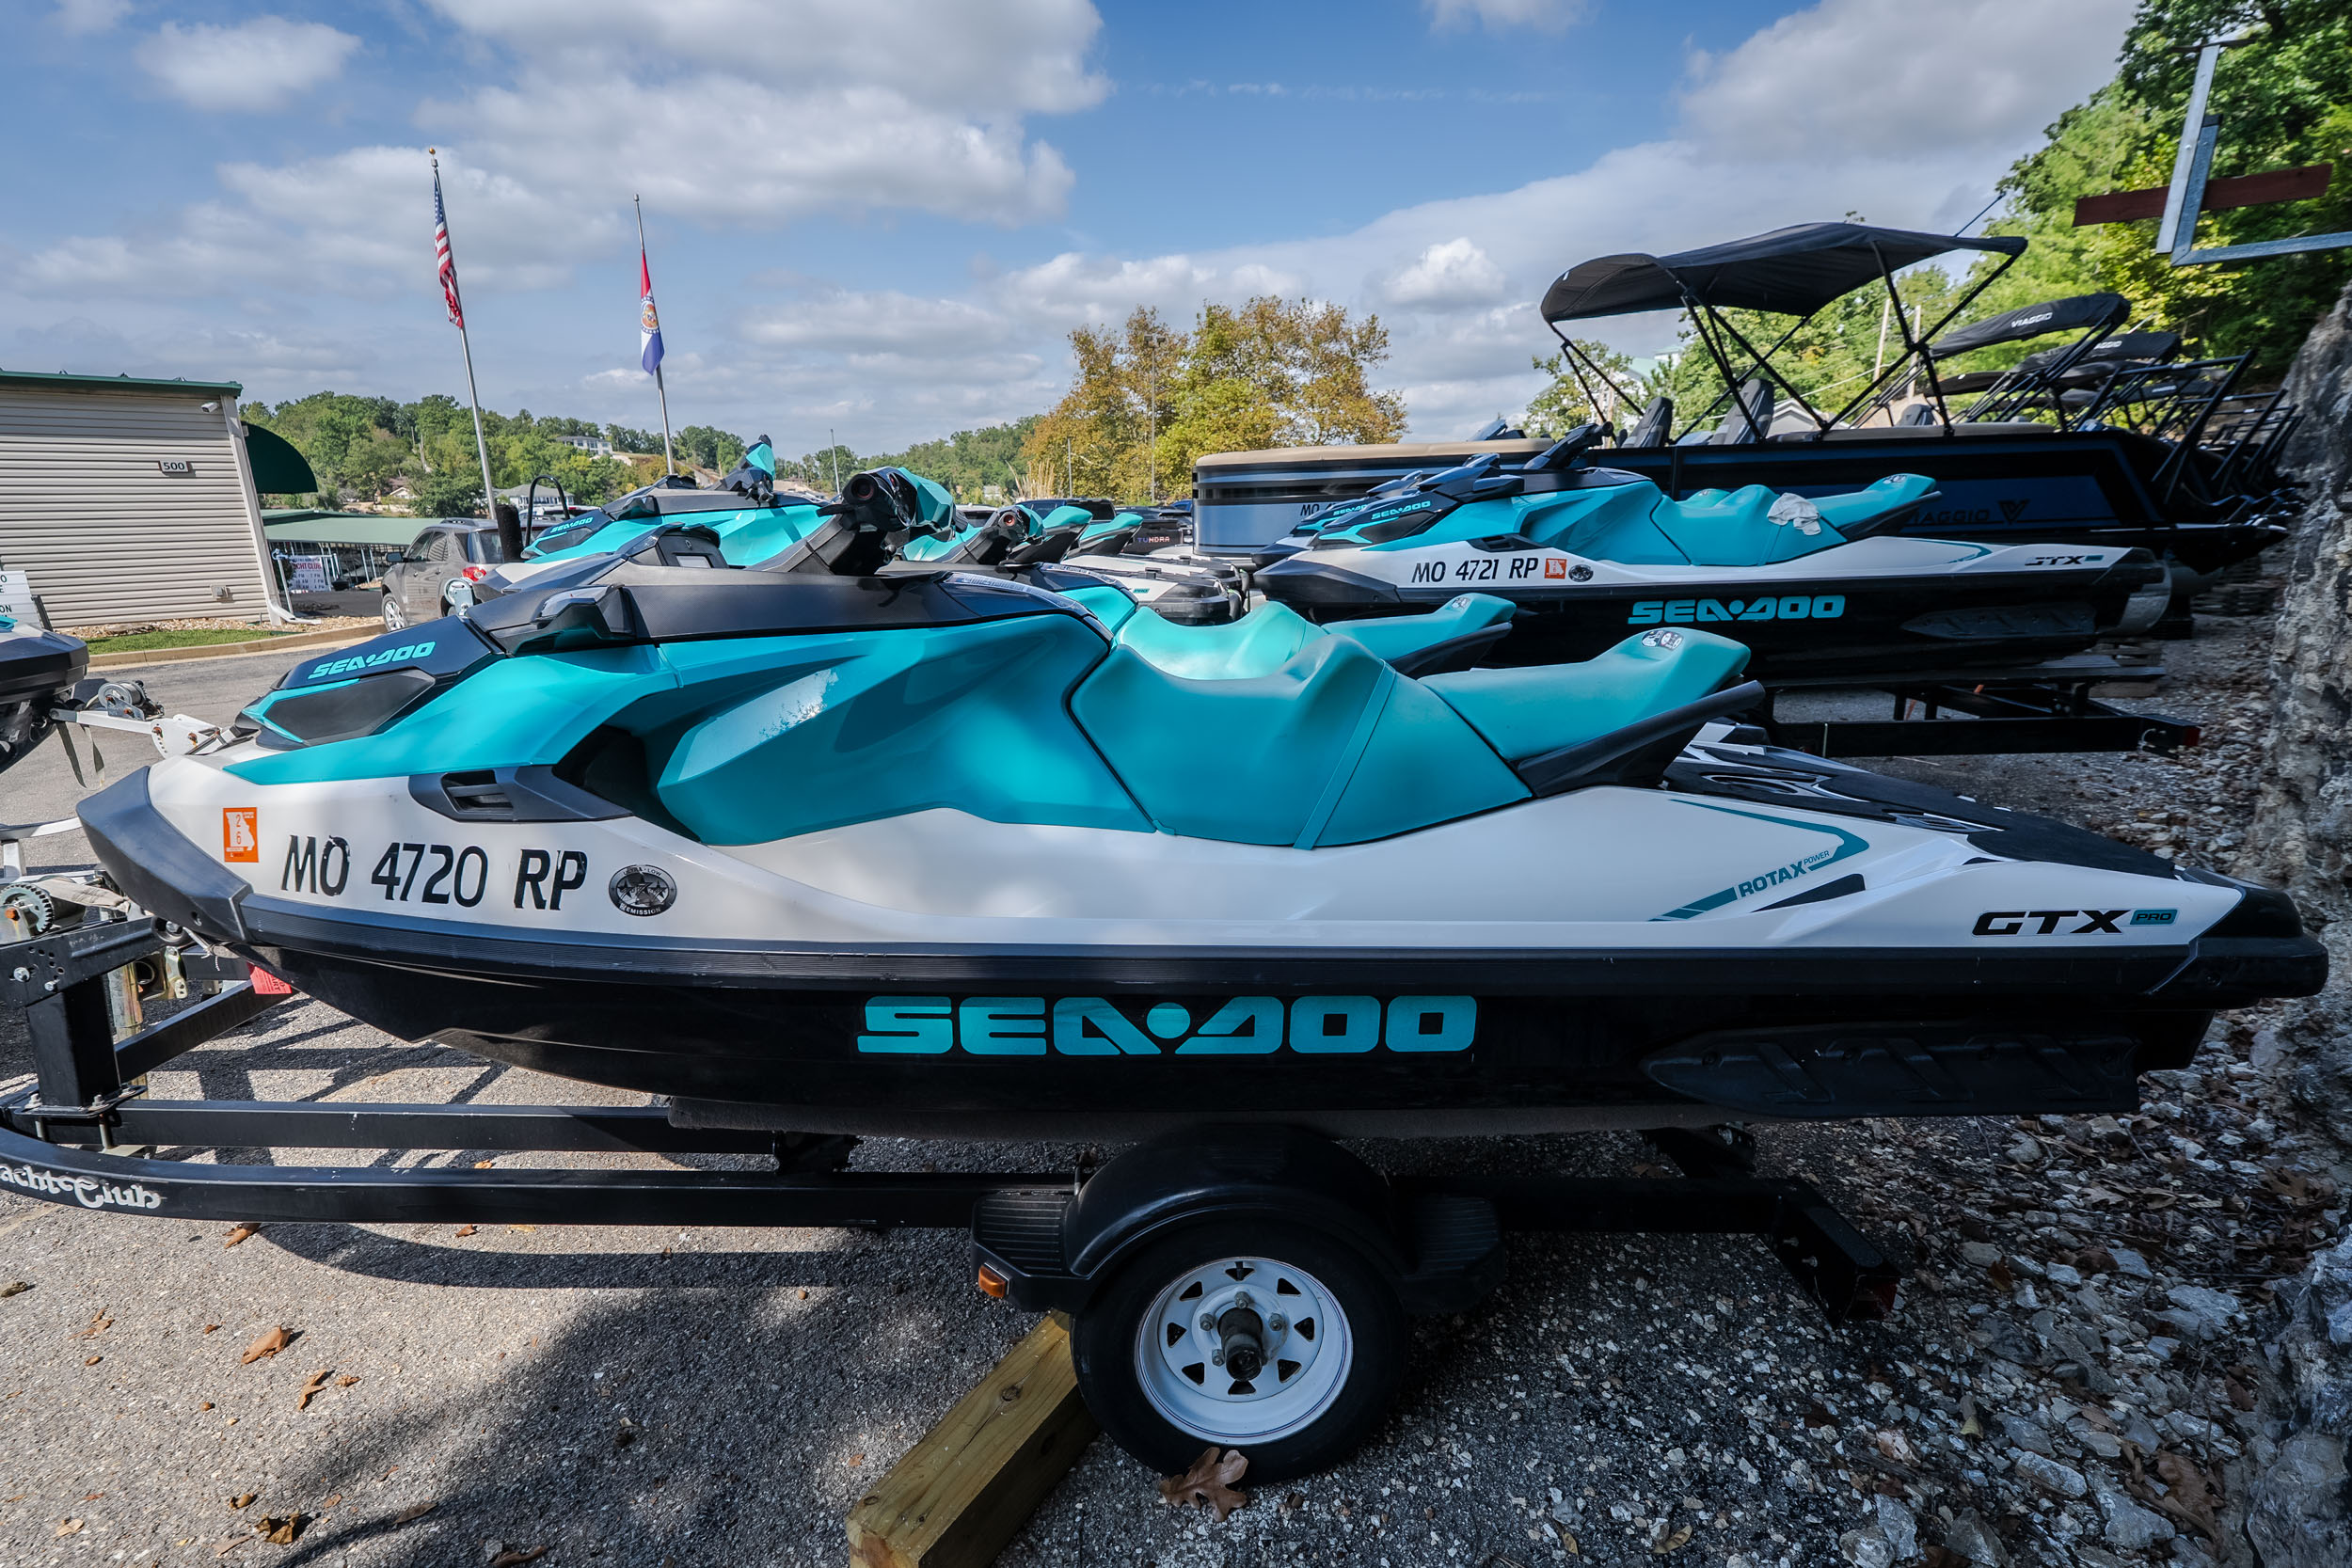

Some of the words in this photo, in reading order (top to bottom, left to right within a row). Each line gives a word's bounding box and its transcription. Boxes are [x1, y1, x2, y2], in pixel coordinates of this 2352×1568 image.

[2010, 311, 2053, 328] VIAGGIO
[2093, 341, 2122, 350] AGGIO
[163, 462, 185, 470] 500
[1300, 503, 1320, 516] MO
[1911, 509, 1990, 526] IAGGIO
[1411, 562, 1446, 583] MO
[1455, 559, 1499, 581] 4721
[1509, 557, 1538, 579] RP
[280, 834, 351, 896] MO
[371, 842, 488, 908] 4720
[513, 848, 588, 911] RP
[1738, 861, 1807, 897] ROTAX
[1804, 850, 1830, 865] POWER
[627, 906, 661, 915] EMISSION
[1972, 909, 2132, 935] GTX
[2136, 912, 2172, 921] PRO
[0, 1164, 61, 1195] acht
